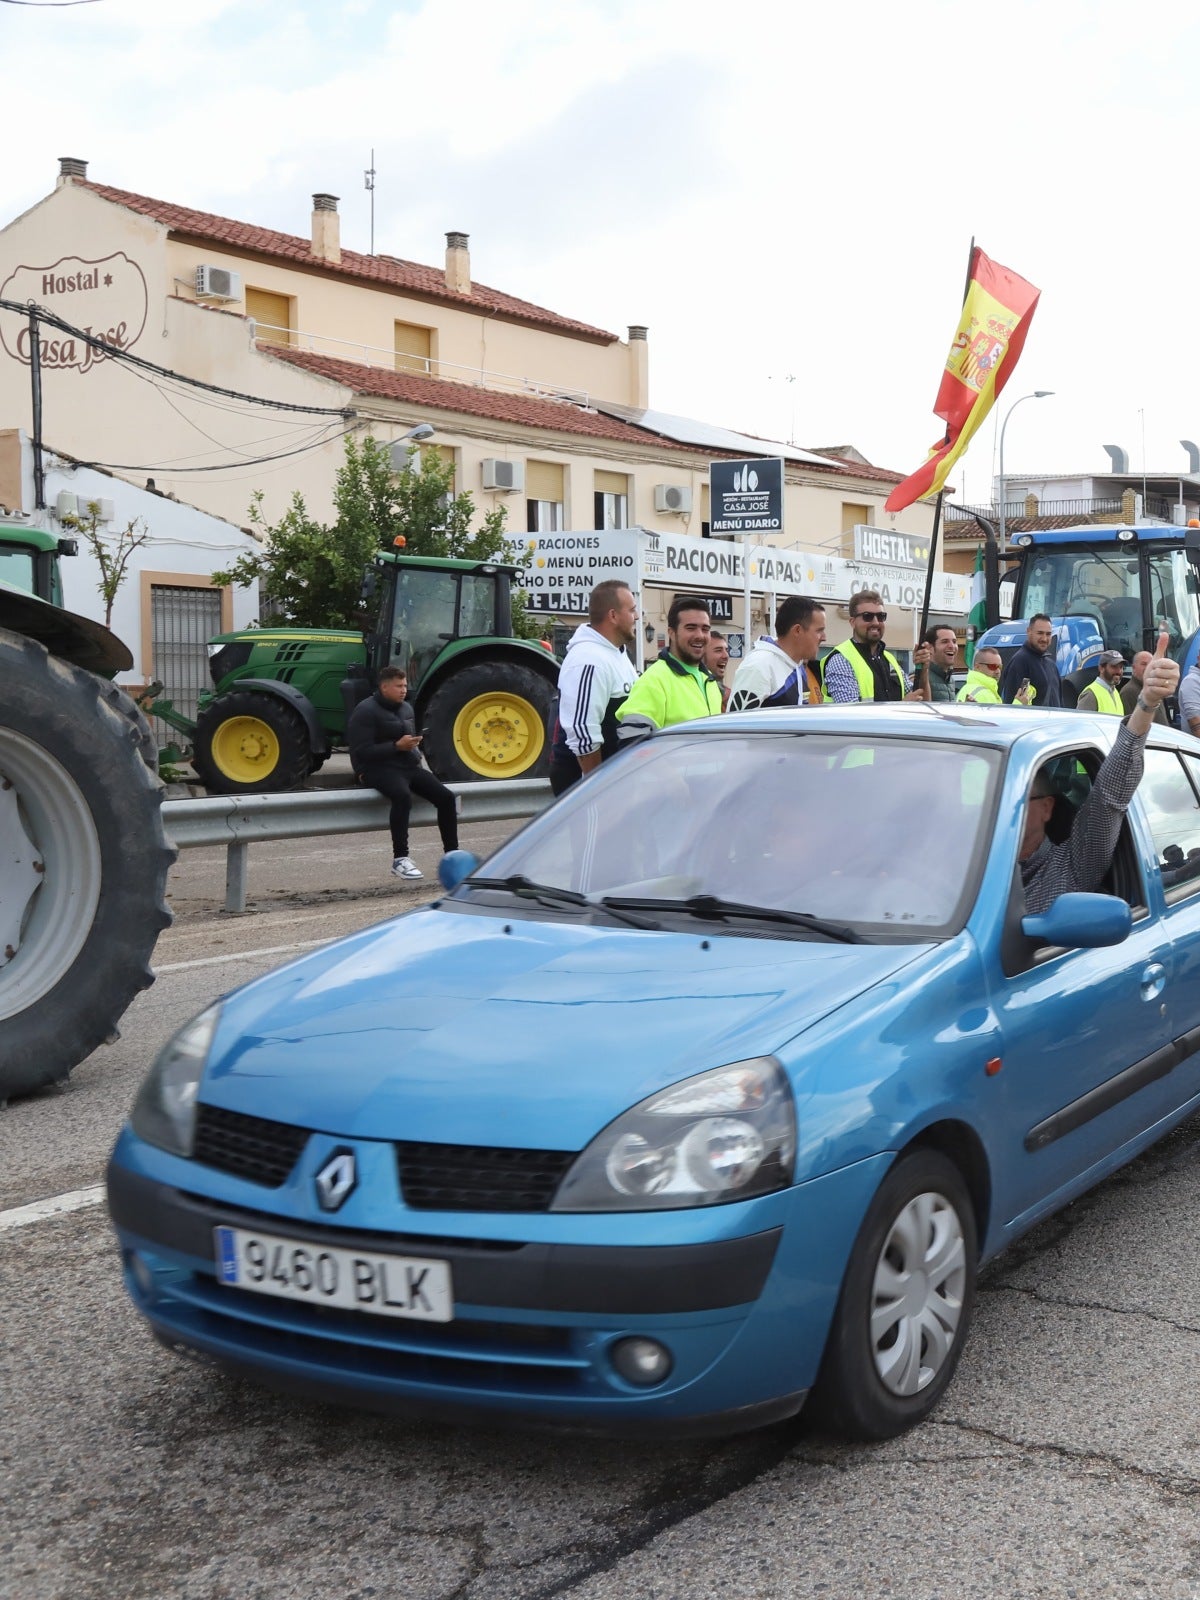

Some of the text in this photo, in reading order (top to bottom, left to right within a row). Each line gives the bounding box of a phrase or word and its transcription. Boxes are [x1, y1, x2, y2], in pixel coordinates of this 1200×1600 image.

[42, 268, 99, 295] Hostal
[724, 501, 769, 511] CASA JOSÉ
[713, 517, 779, 530] MENÚ DIARIO
[538, 537, 600, 550] RACIONES
[862, 531, 914, 563] HOSTAL
[547, 553, 584, 568] MENÚ
[589, 556, 634, 567] DIARIO
[757, 558, 802, 584] TAPAS
[549, 576, 564, 587] DE
[568, 576, 594, 587] PAN
[896, 585, 931, 607] JOS
[707, 599, 731, 616] TAL
[245, 1240, 433, 1312] 9460 BLK
